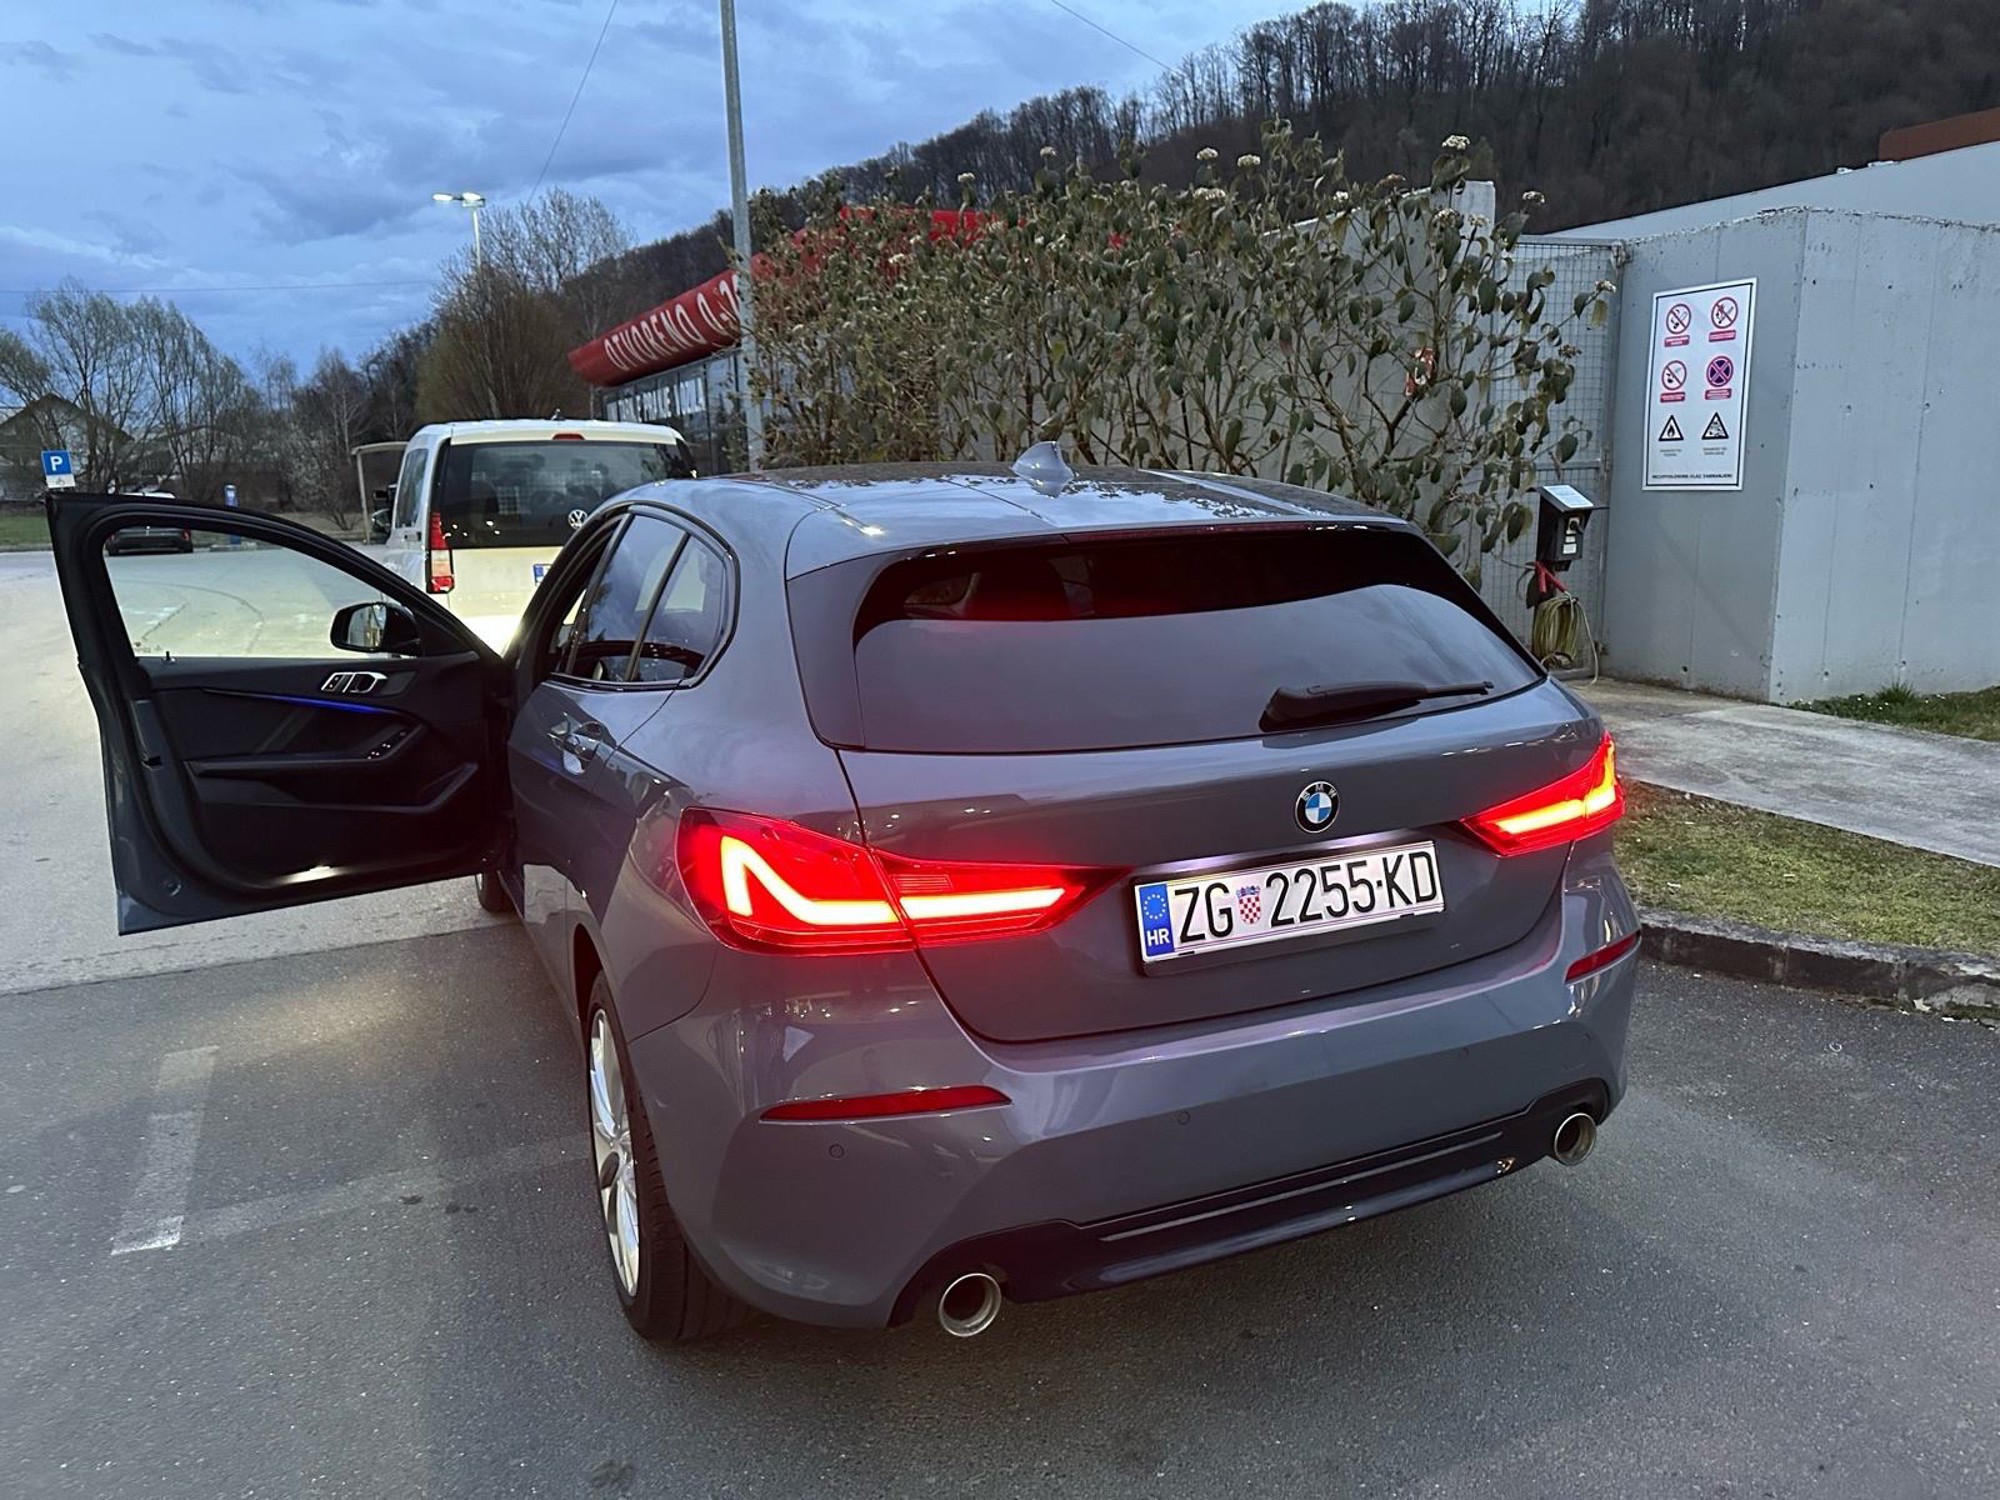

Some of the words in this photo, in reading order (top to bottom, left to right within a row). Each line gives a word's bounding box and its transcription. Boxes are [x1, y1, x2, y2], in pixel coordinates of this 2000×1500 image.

[604, 303, 707, 371] OTVORENO
[50, 455, 63, 472] P
[1175, 882, 1233, 943] ZG
[1147, 928, 1170, 947] HR
